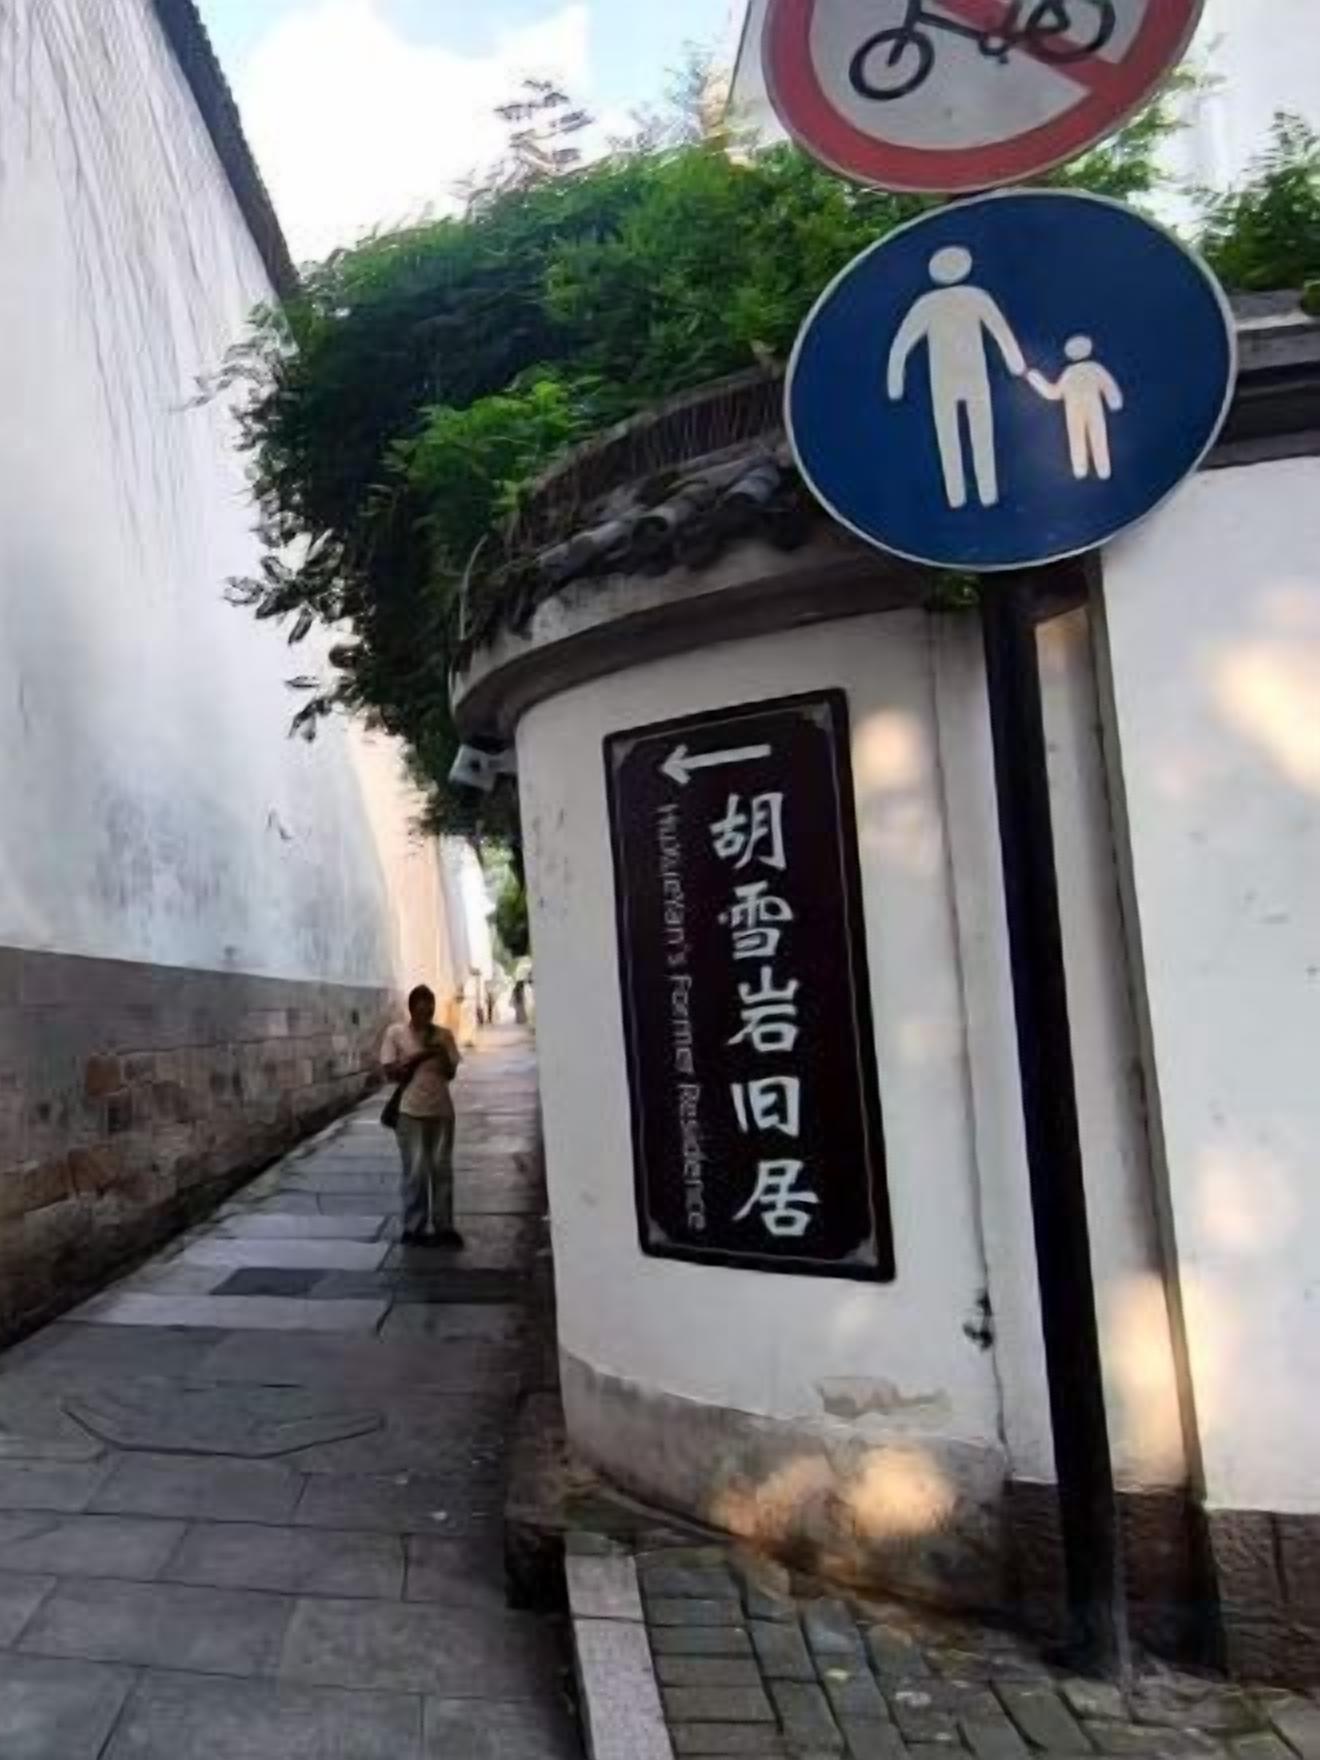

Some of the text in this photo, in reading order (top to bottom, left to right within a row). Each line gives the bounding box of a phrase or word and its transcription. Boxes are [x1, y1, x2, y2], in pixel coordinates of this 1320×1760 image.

[669, 974, 696, 1075] Former
[709, 790, 822, 1238] 胡雪岩旧居
[678, 1083, 707, 1231] Residence
